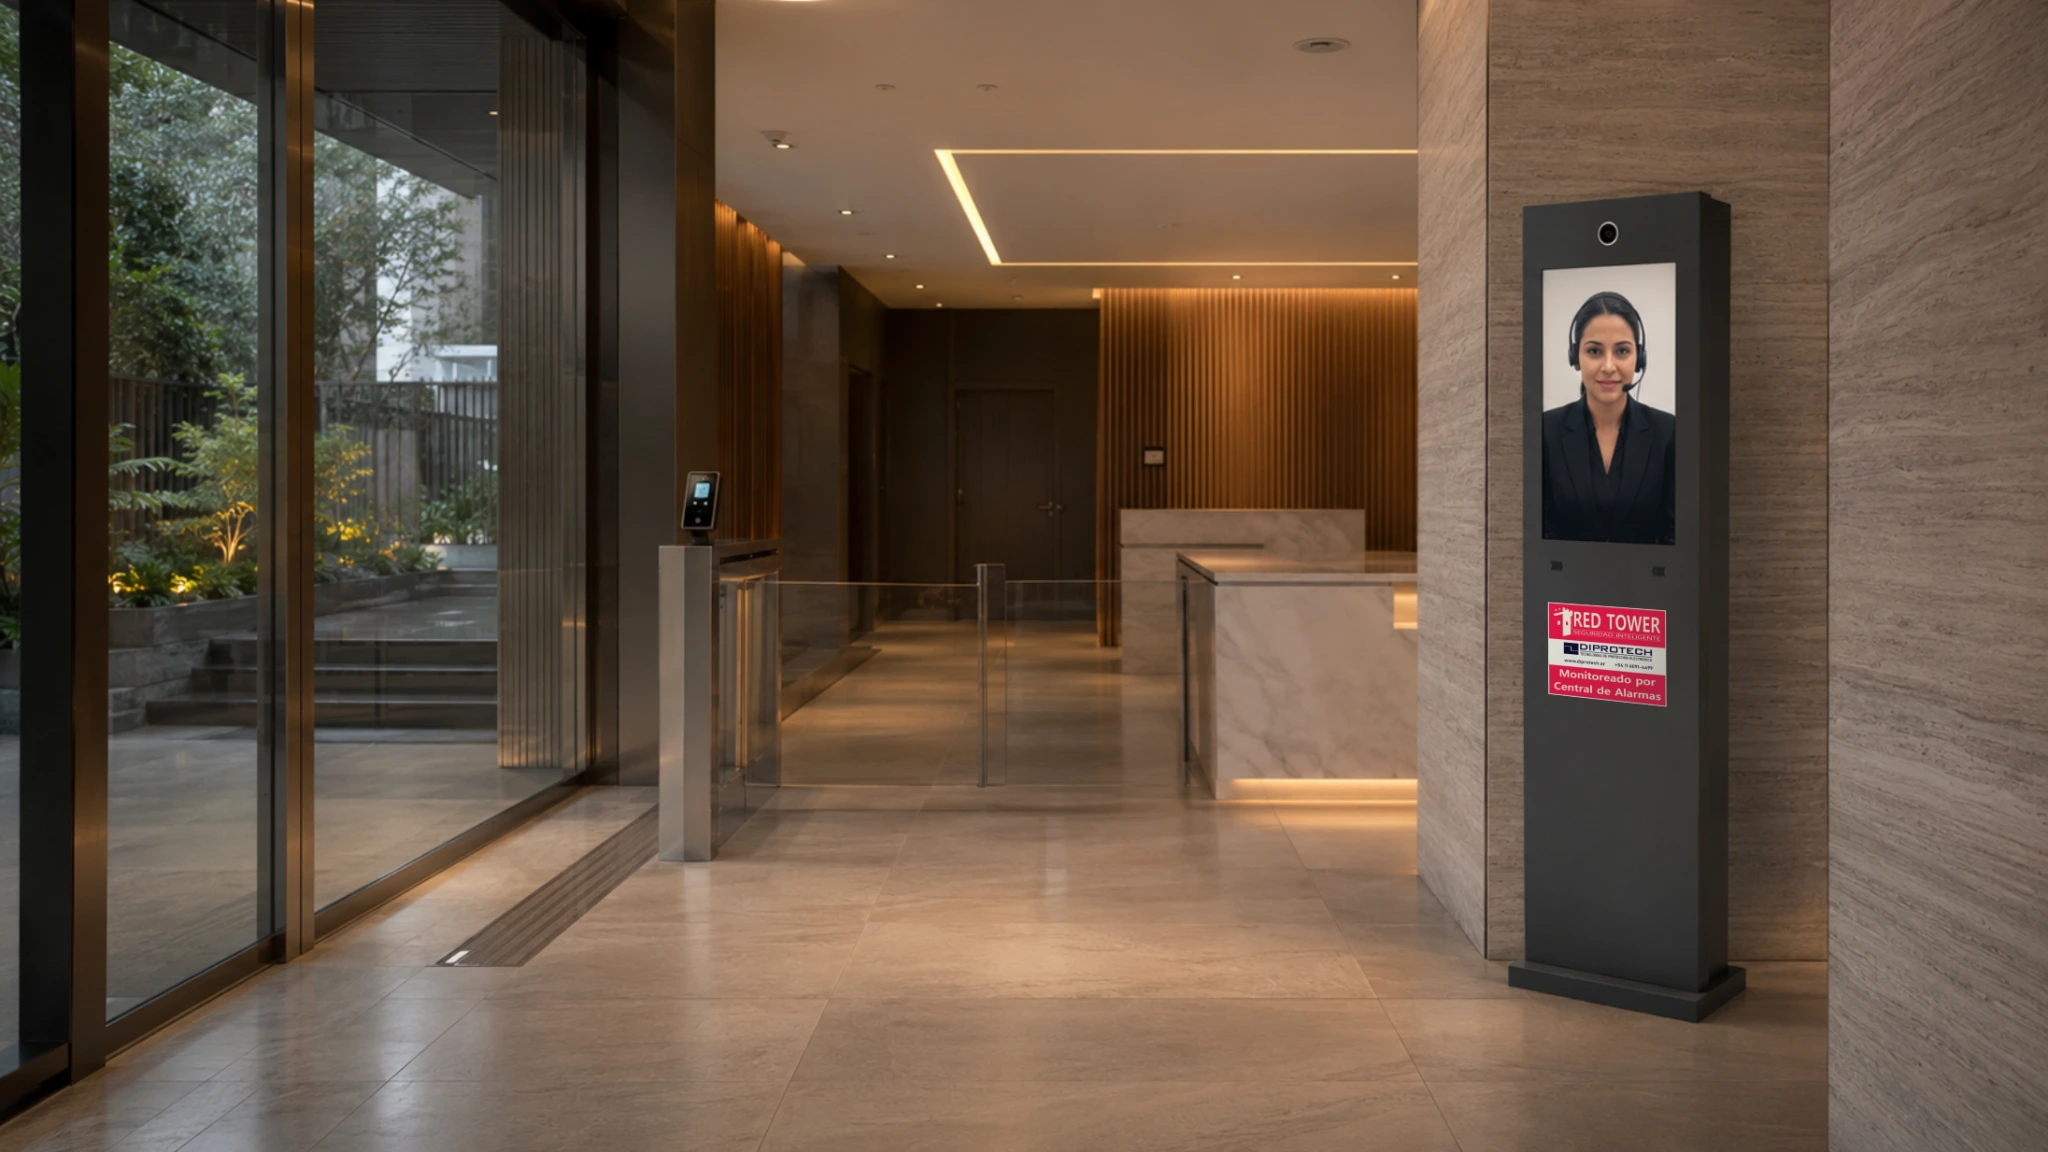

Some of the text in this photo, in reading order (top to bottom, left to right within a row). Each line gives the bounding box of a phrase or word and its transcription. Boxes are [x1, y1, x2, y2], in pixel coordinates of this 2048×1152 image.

[1574, 611, 1660, 634] RED TOWER
[1573, 630, 1661, 642] SEGURIDAD INTELIGENTE
[1580, 644, 1652, 656] DIPROTECH
[1559, 669, 1656, 687] Monitoreado por
[1554, 682, 1661, 701] Central de Alarmas
